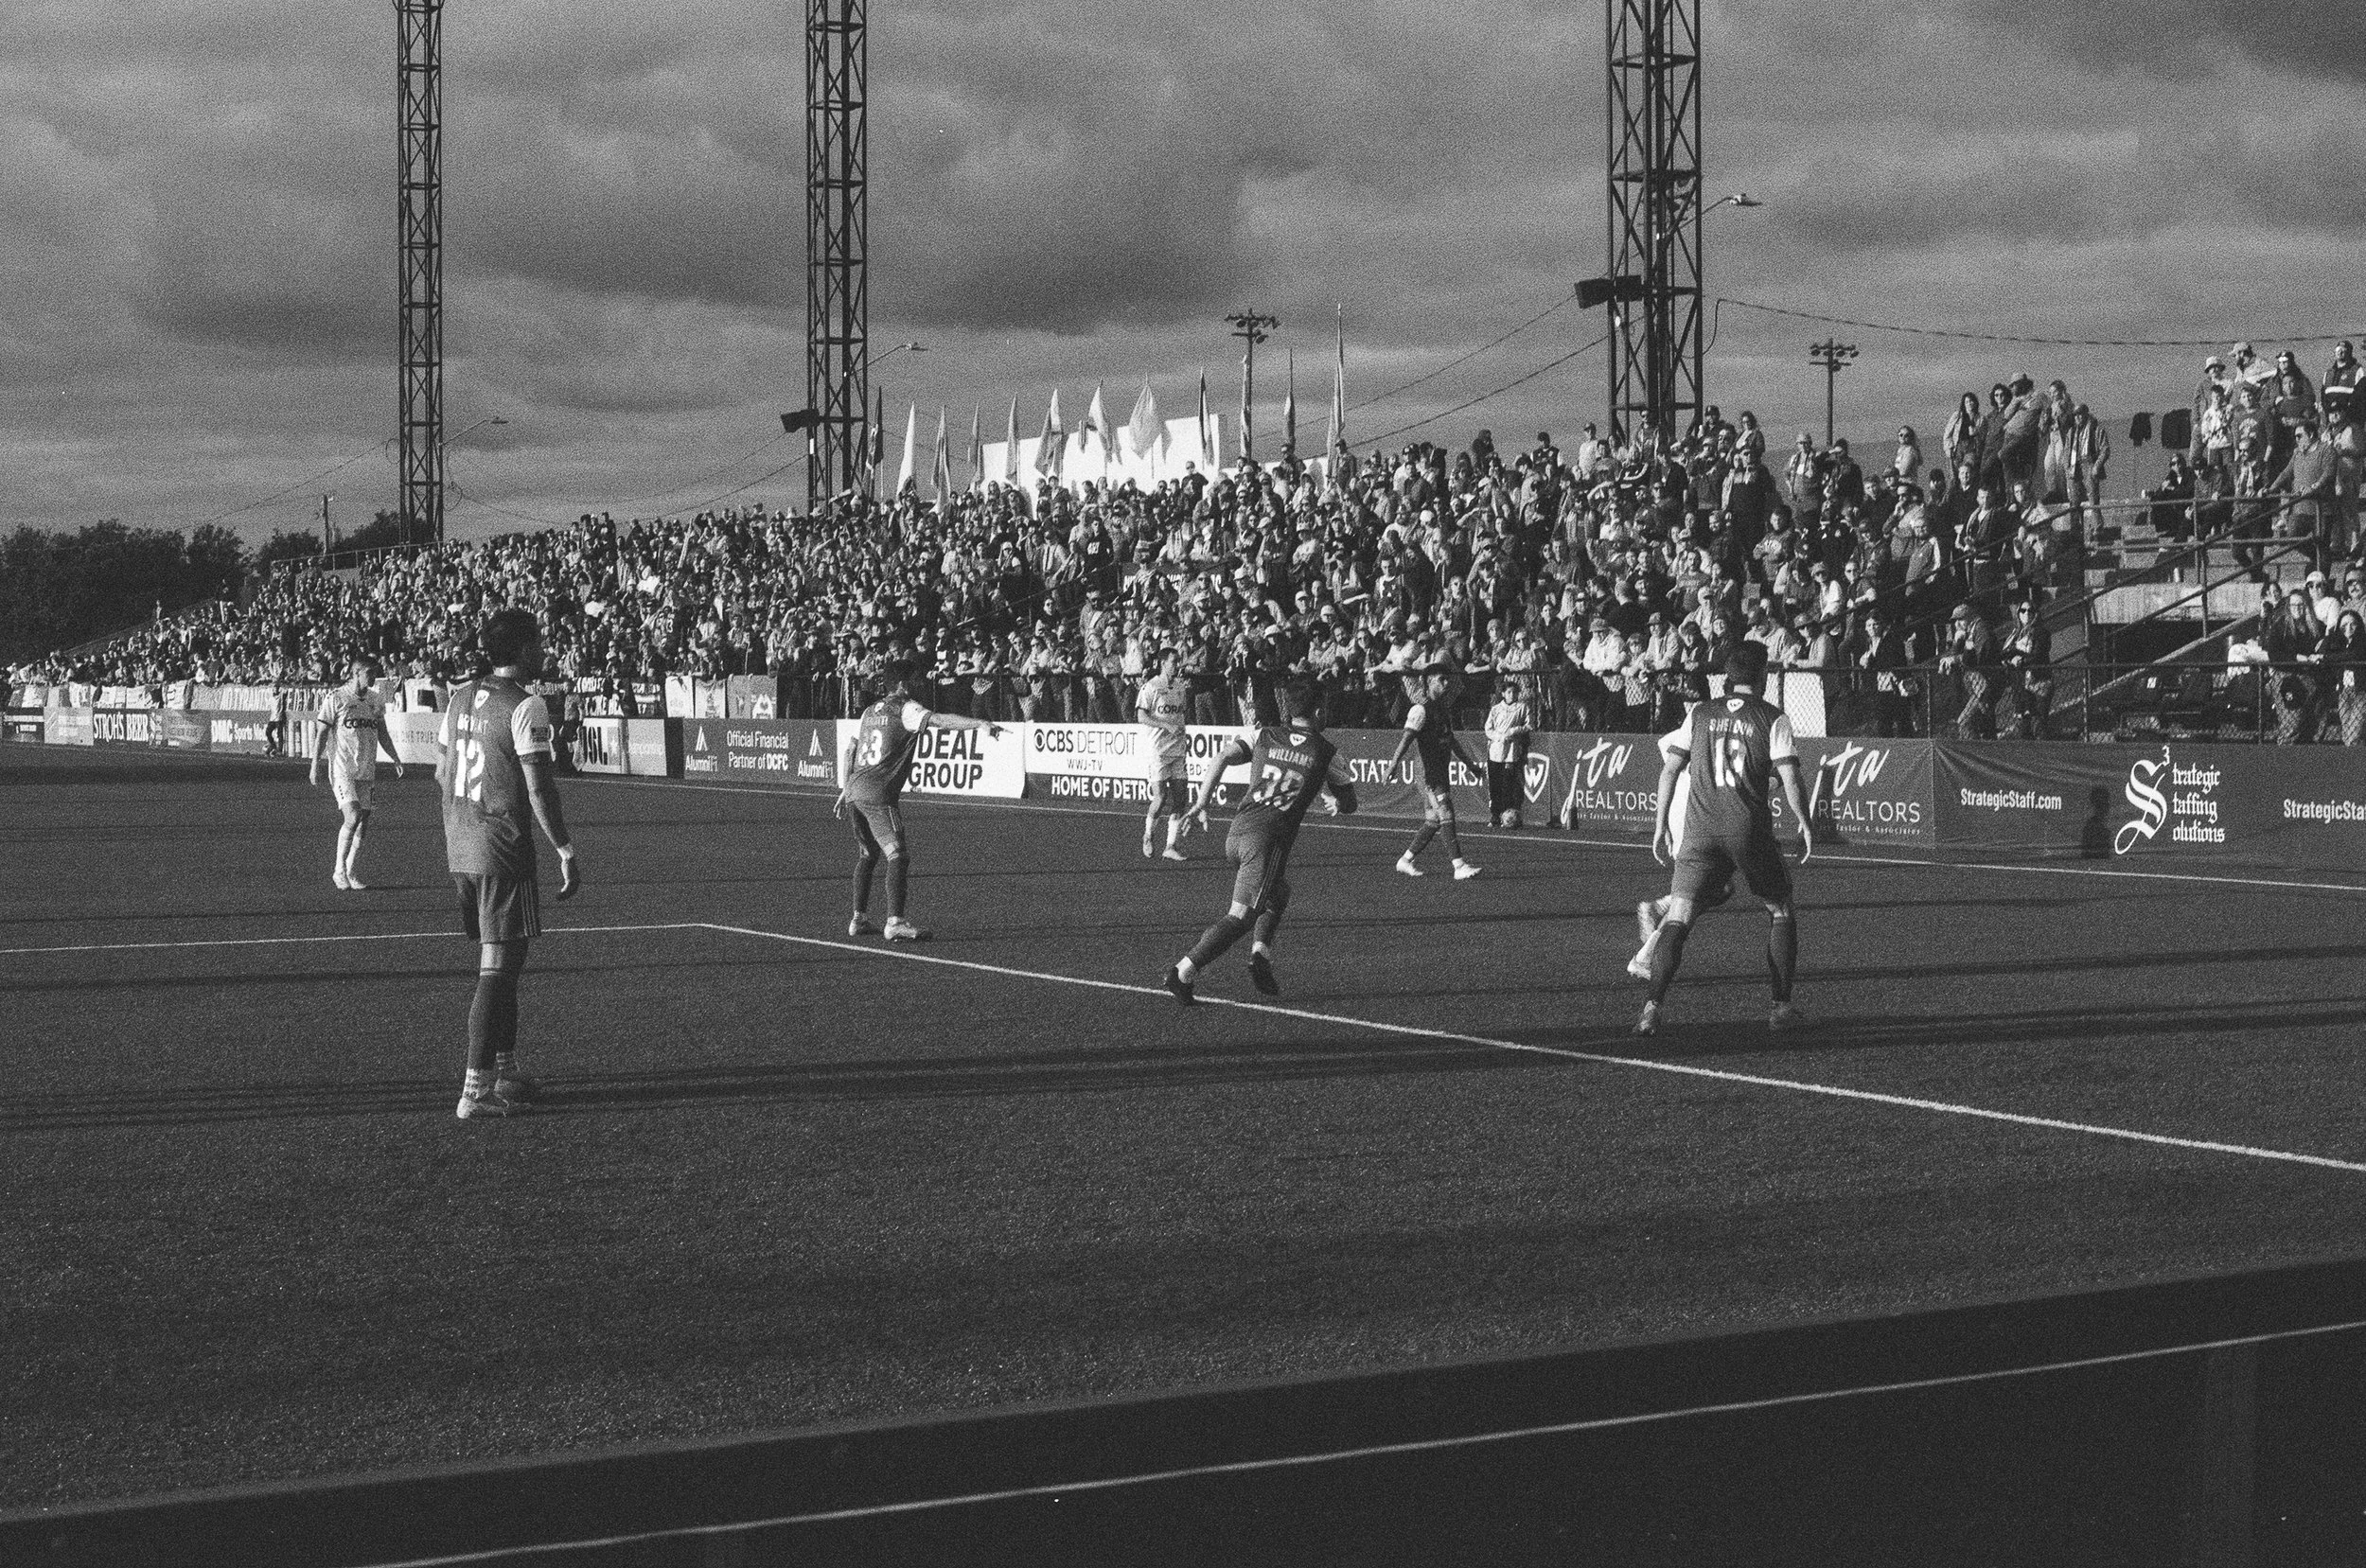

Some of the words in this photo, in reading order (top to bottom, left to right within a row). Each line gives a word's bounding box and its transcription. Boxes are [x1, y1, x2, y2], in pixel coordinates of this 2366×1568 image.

[126, 714, 149, 742] BEER
[211, 719, 233, 743] DMC
[727, 730, 753, 747] Official
[754, 731, 788, 749] Financial
[1047, 730, 1074, 752] CBS
[1077, 731, 1138, 755] DETROIT
[454, 738, 486, 802] 12
[728, 751, 756, 769] Partner
[757, 753, 766, 769] of
[766, 753, 788, 771] DCFC
[1067, 759, 1103, 771] WWJ-TV
[909, 762, 983, 789] GROUP
[1051, 776, 1089, 797] HOME
[1091, 777, 1111, 798] OF
[1576, 790, 1658, 811] REALTORS
[1818, 800, 1920, 822] REALTORS
[1961, 787, 2062, 812] StrategicStaff.com
[2284, 799, 2366, 824] StrategicSta
